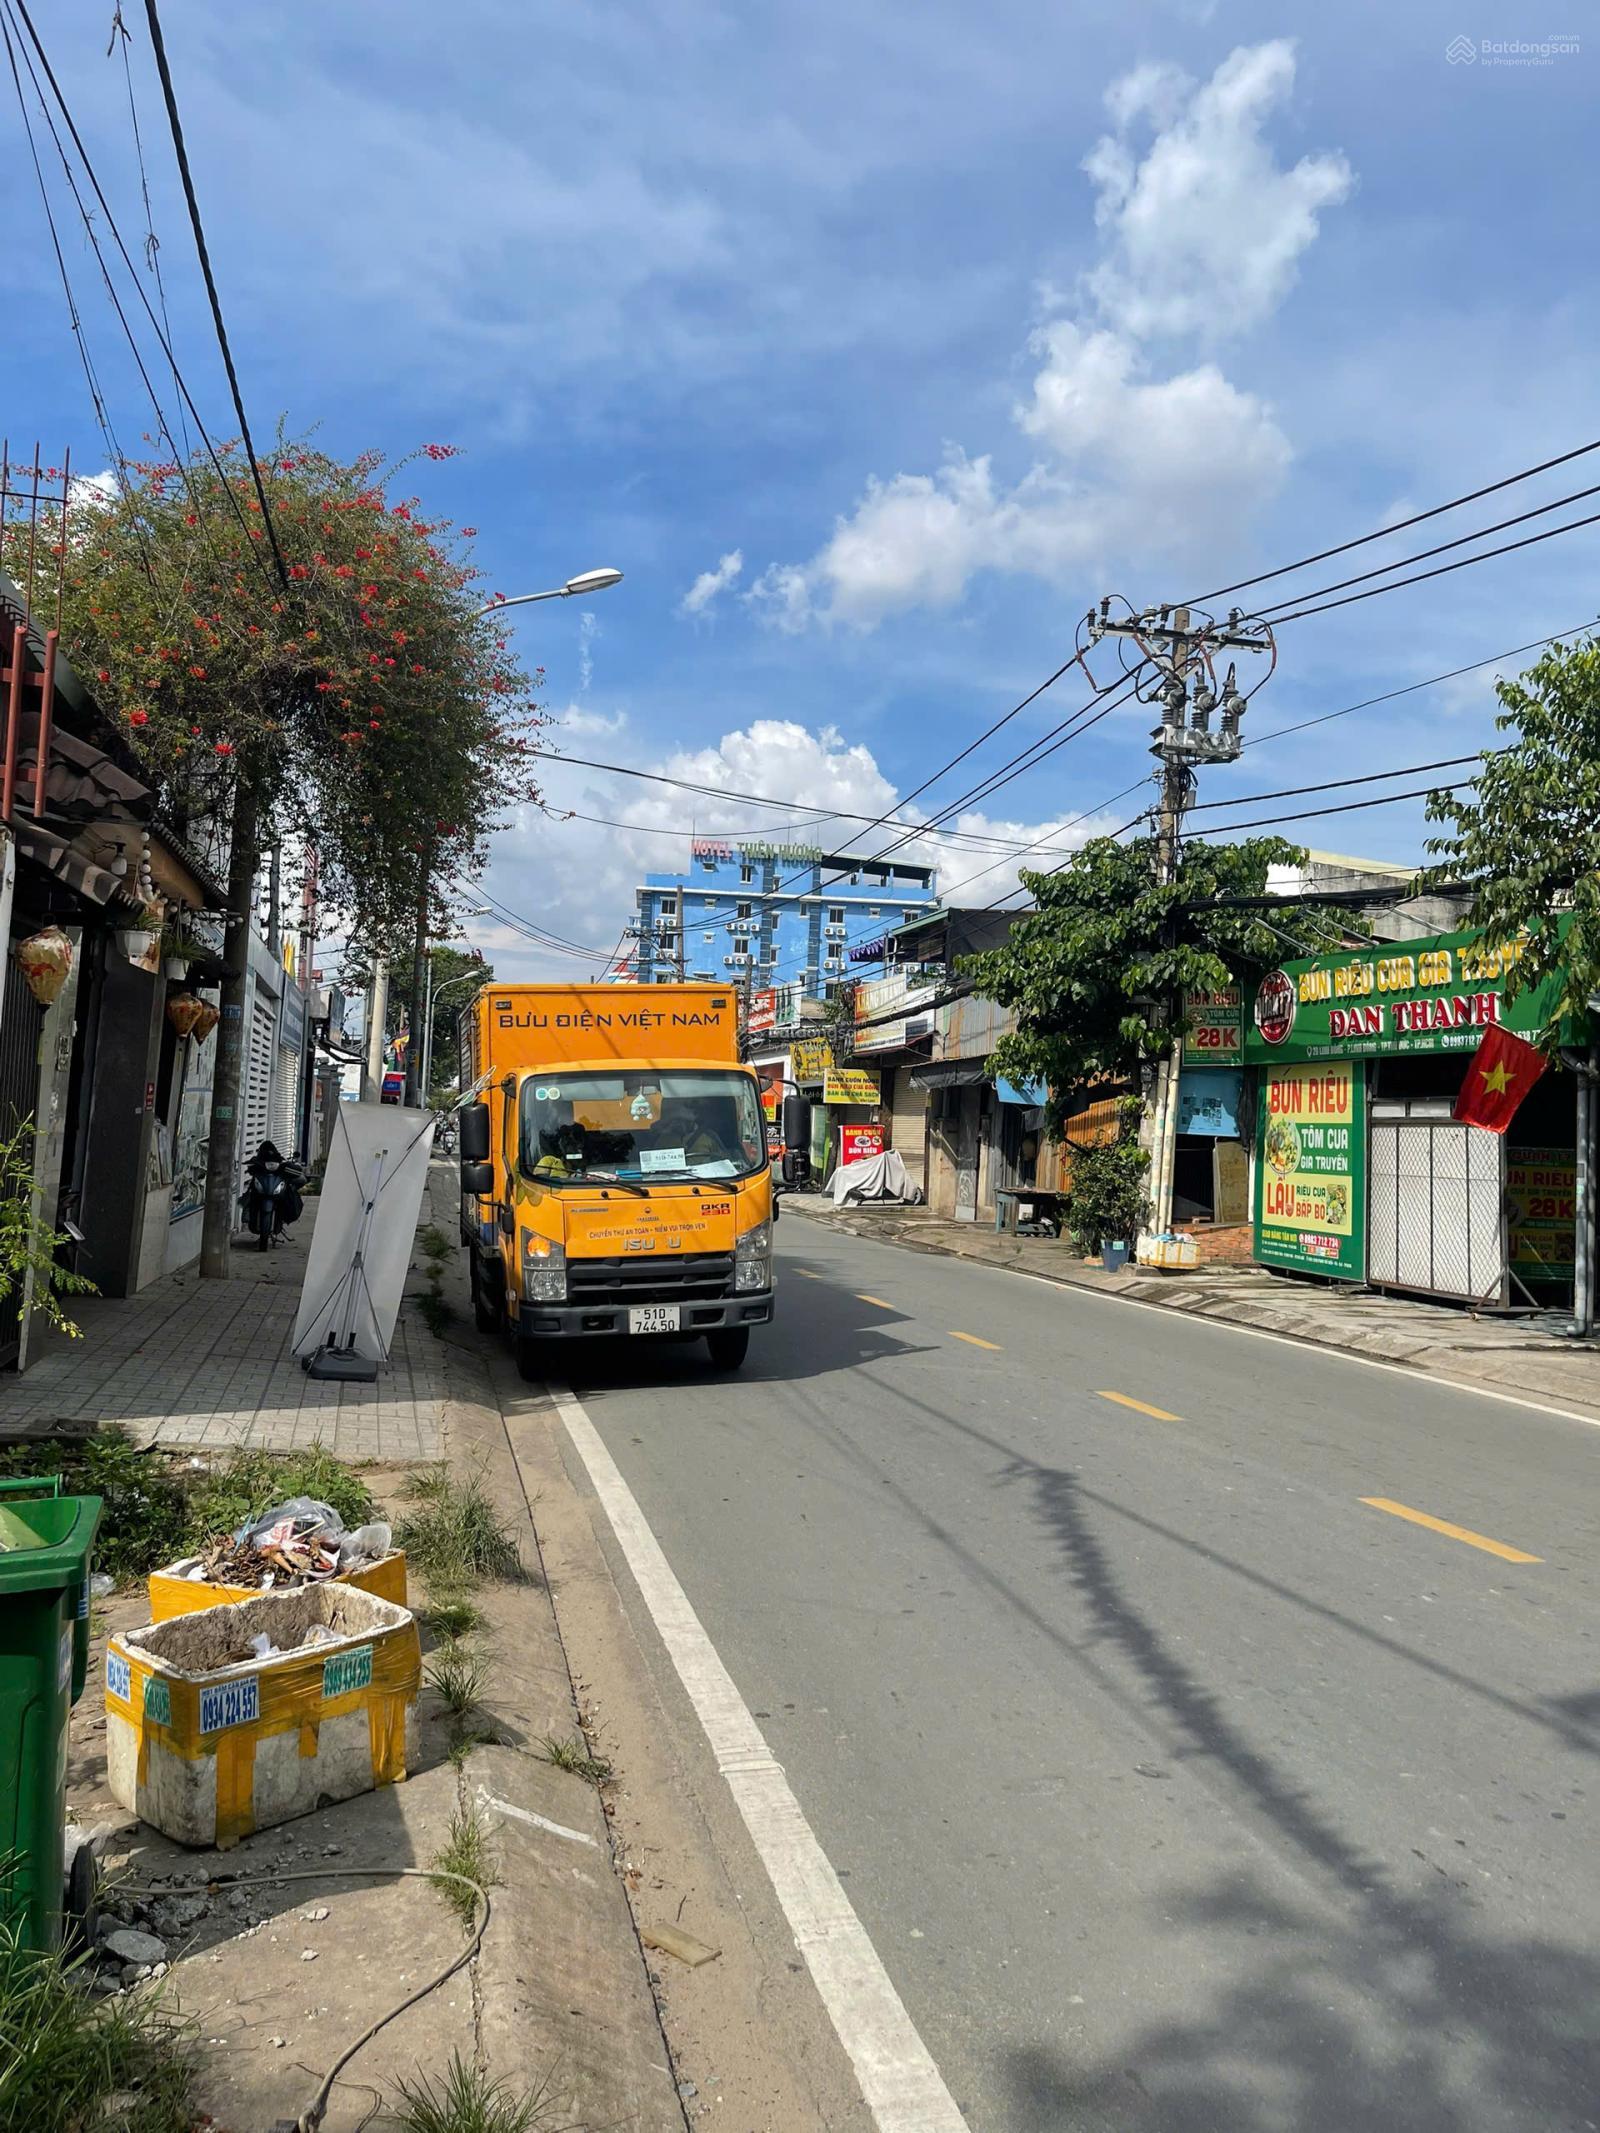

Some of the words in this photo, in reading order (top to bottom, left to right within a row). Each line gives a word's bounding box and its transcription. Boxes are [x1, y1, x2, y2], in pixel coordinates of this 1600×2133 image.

[692, 840, 732, 858] HOTEL
[737, 840, 775, 860] THIÊN
[1299, 962, 1331, 1003] BÚN
[1334, 958, 1374, 998] RIÊU
[1377, 955, 1415, 992] CUA
[1418, 950, 1452, 987] GIA
[499, 1011, 548, 1028] BƯU
[556, 1009, 612, 1031] ĐIỆN
[618, 1009, 666, 1030] VIỆT
[672, 1012, 720, 1026] NAM
[1329, 1004, 1385, 1038] ĐAN
[1391, 991, 1502, 1033] THANH
[1270, 1067, 1302, 1114] BÚN
[1309, 1069, 1348, 1114] RIÊU
[1301, 1125, 1324, 1149] TÔM
[1327, 1128, 1348, 1149] CUA
[1300, 1155, 1313, 1170] GIA
[1315, 1153, 1348, 1171] TRUYỀN
[644, 1308, 666, 1320] 51D
[635, 1319, 675, 1333] 744.50
